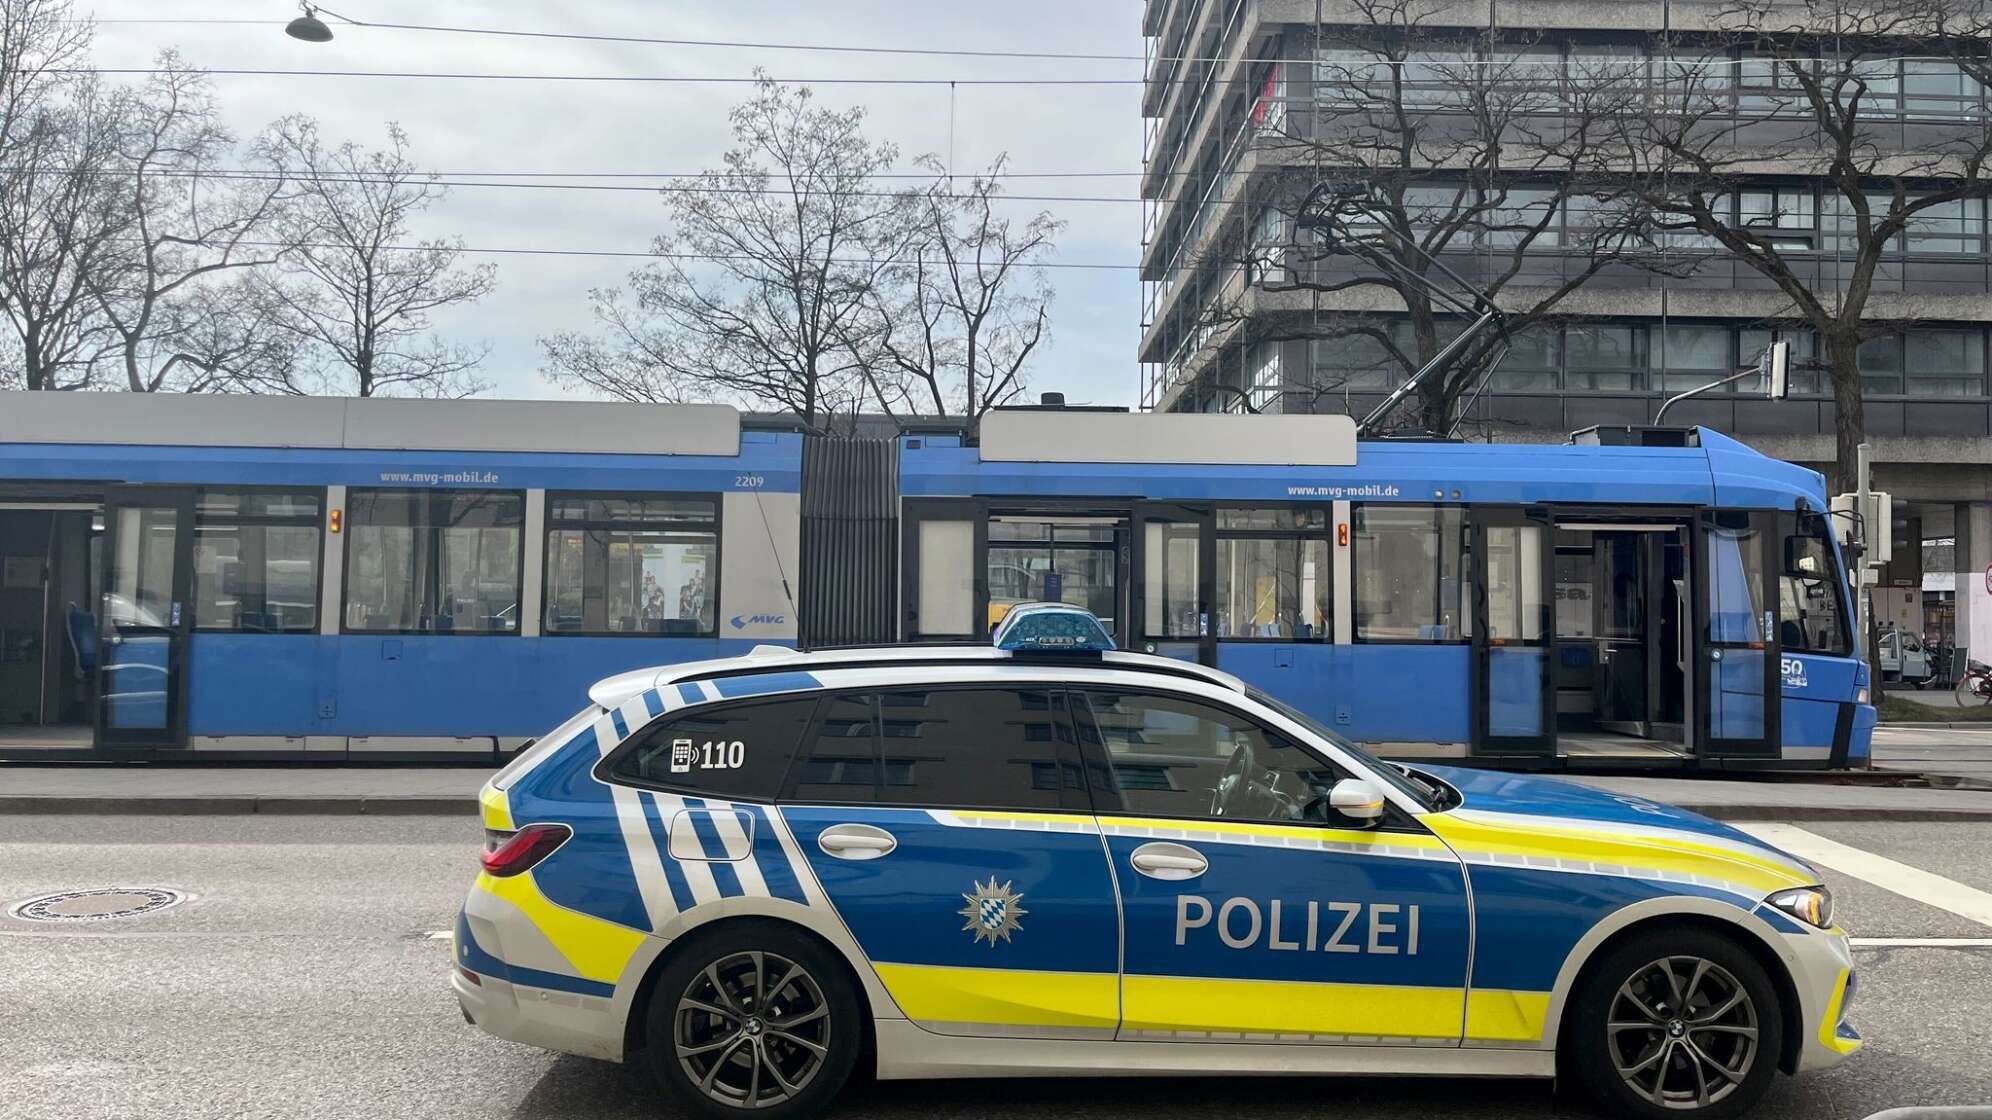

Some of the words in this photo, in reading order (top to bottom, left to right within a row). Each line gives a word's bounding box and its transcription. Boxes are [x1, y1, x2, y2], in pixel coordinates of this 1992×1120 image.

[380, 472, 499, 485] www.mvg-mobil.de
[735, 476, 764, 487] 2209
[1287, 485, 1400, 498] www.mvg-mobil.de
[748, 615, 785, 624] MVG
[700, 741, 745, 769] 110
[1175, 894, 1420, 956] POLIZEI
